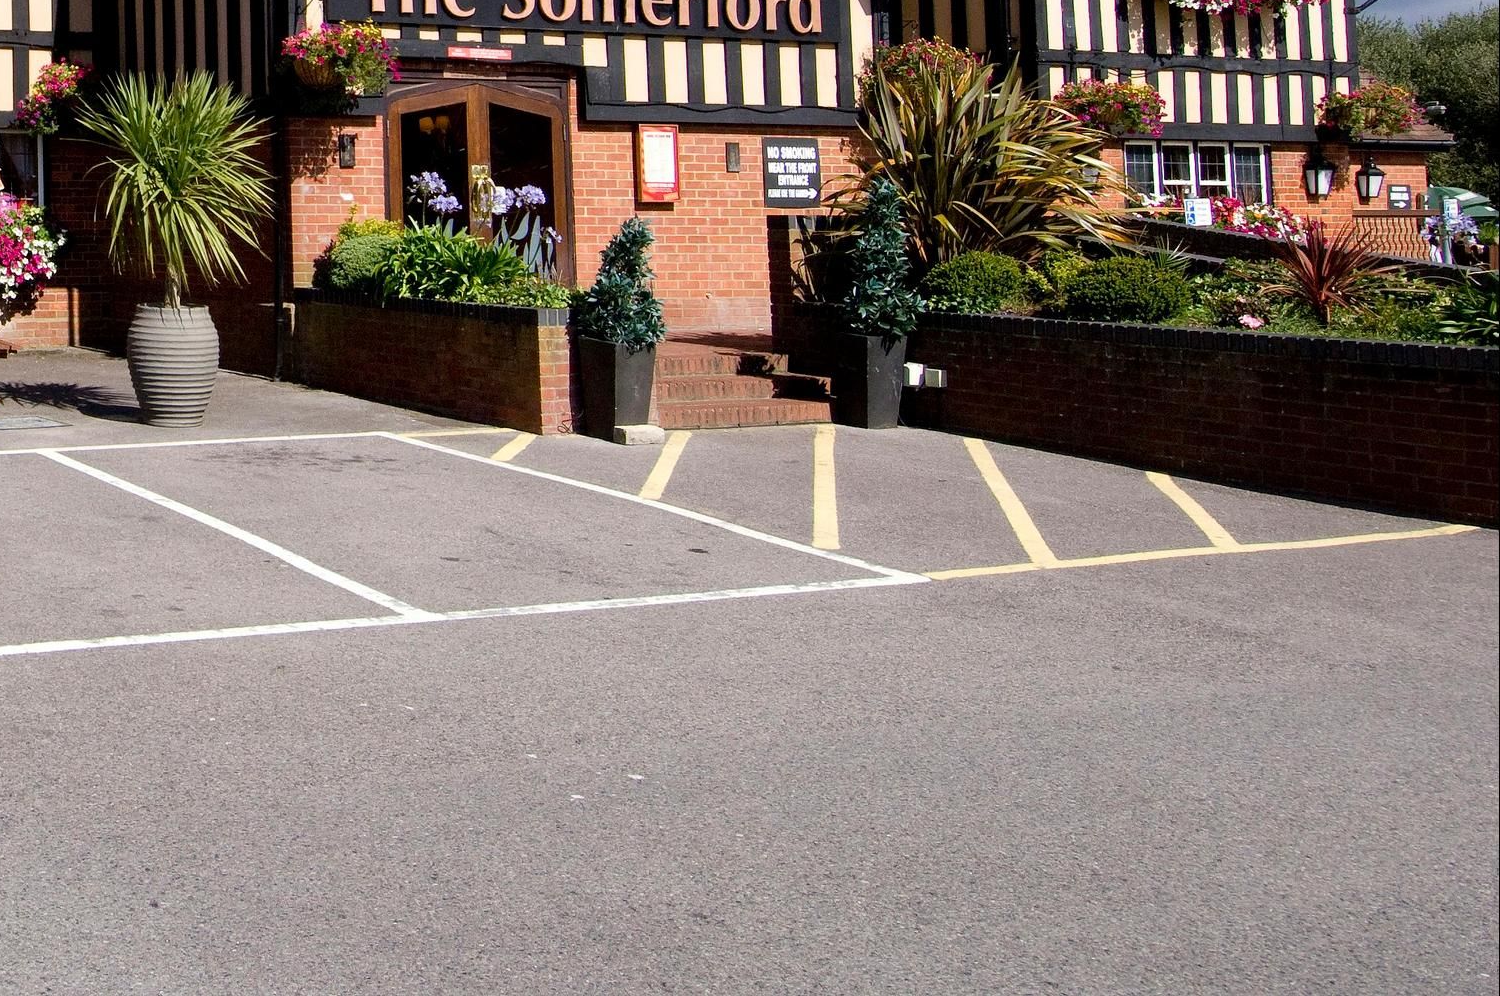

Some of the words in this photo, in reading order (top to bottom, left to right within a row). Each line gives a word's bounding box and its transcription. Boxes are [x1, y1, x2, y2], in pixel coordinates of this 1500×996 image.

[767, 146, 780, 159] NO
[781, 146, 816, 159] SMOKING
[785, 162, 798, 174] THE
[798, 162, 817, 174] FRONT
[778, 175, 809, 186] ENTRANCE
